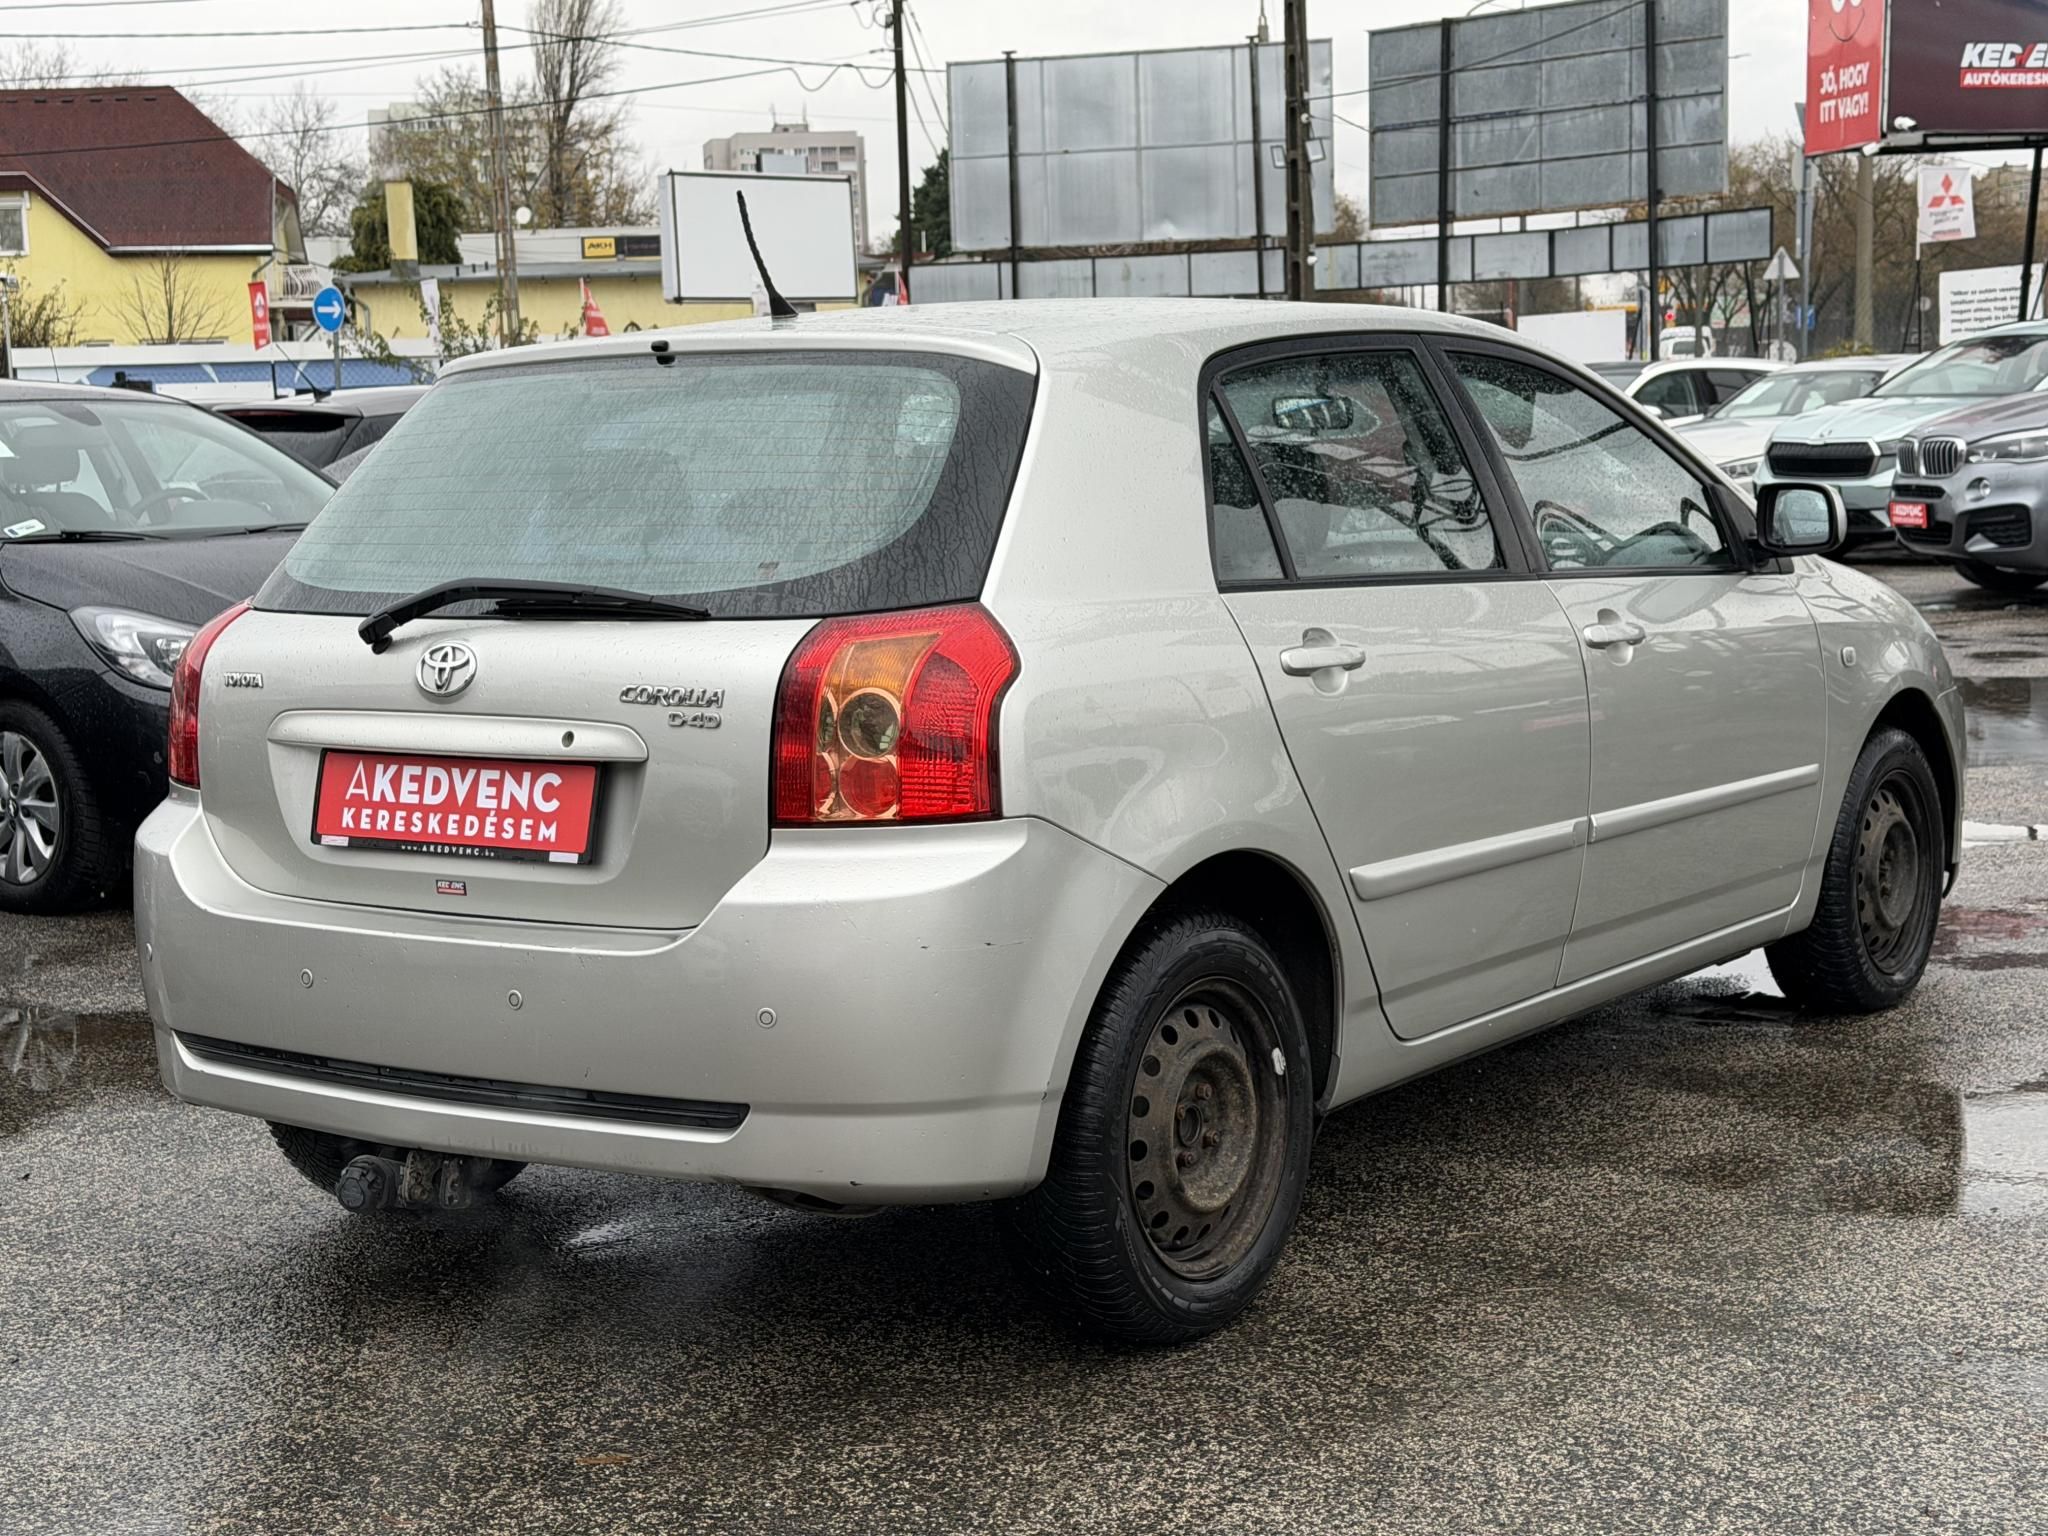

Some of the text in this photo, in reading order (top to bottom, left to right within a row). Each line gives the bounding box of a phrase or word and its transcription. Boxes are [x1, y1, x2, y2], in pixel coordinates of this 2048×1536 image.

[1961, 43, 2048, 67] KEDVE
[1820, 62, 1870, 96] JÓ, HOGY
[1820, 92, 1869, 124] ITT VAGY!
[223, 671, 264, 689] TOYOTA
[619, 683, 725, 708] COROLLA
[668, 710, 722, 729] D-4D
[345, 759, 563, 813] AKEDVENC
[341, 807, 558, 842] KERESKEDÉSEM
